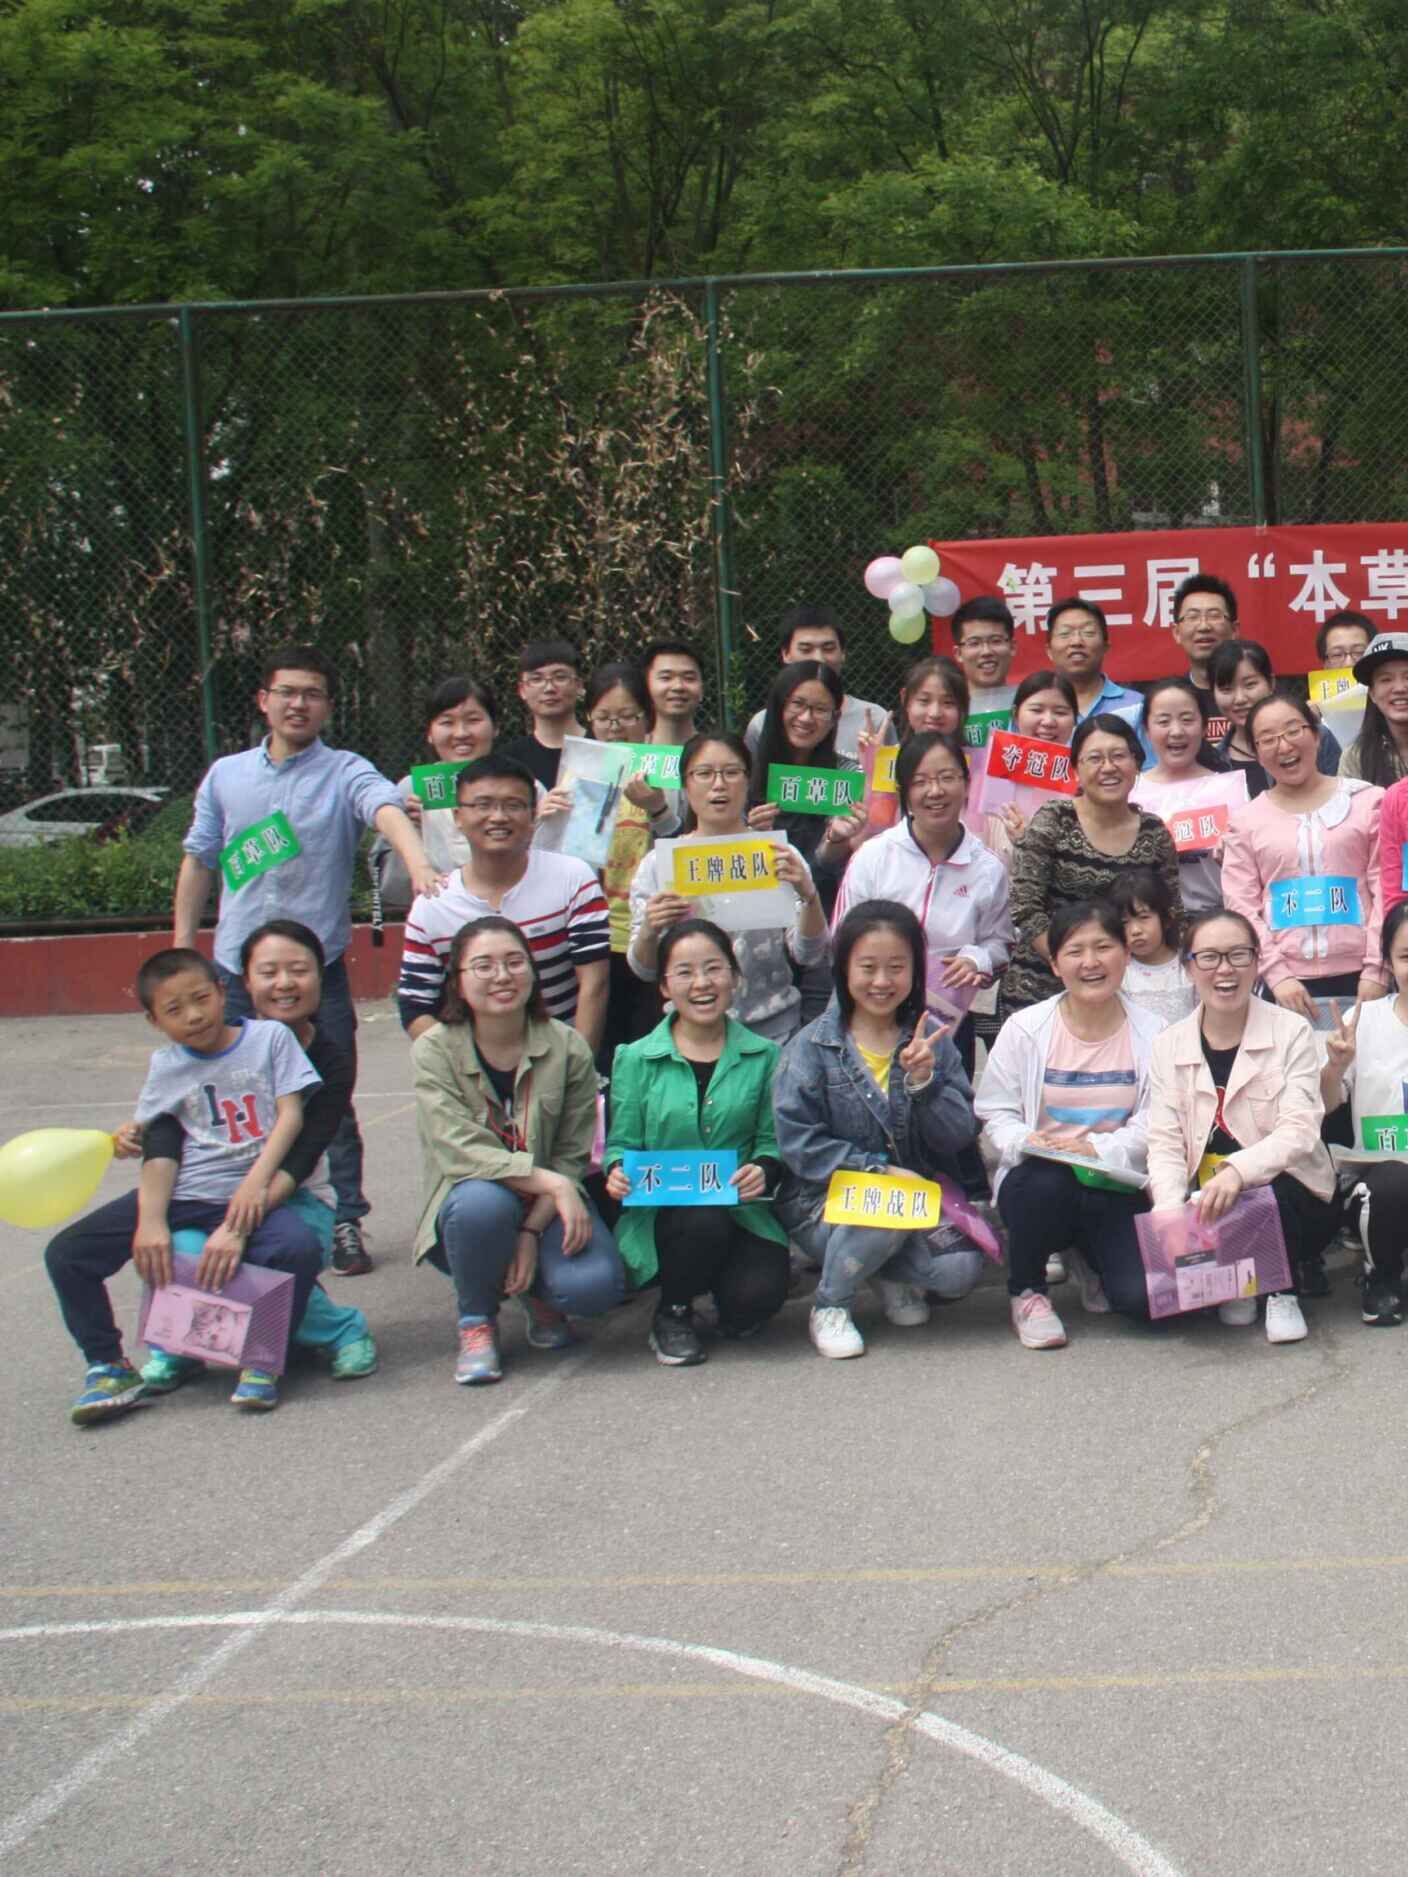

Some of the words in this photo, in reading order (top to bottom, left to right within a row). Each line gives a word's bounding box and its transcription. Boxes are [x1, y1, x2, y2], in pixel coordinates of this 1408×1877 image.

[1002, 744, 1070, 783] 夺冠队
[780, 776, 853, 806] 百草队
[227, 826, 289, 880] 百草队
[688, 852, 769, 883] 王牌战队
[1281, 887, 1350, 918] 不二队
[637, 1162, 723, 1193] 不二队
[839, 1184, 929, 1218] 王牌战队
